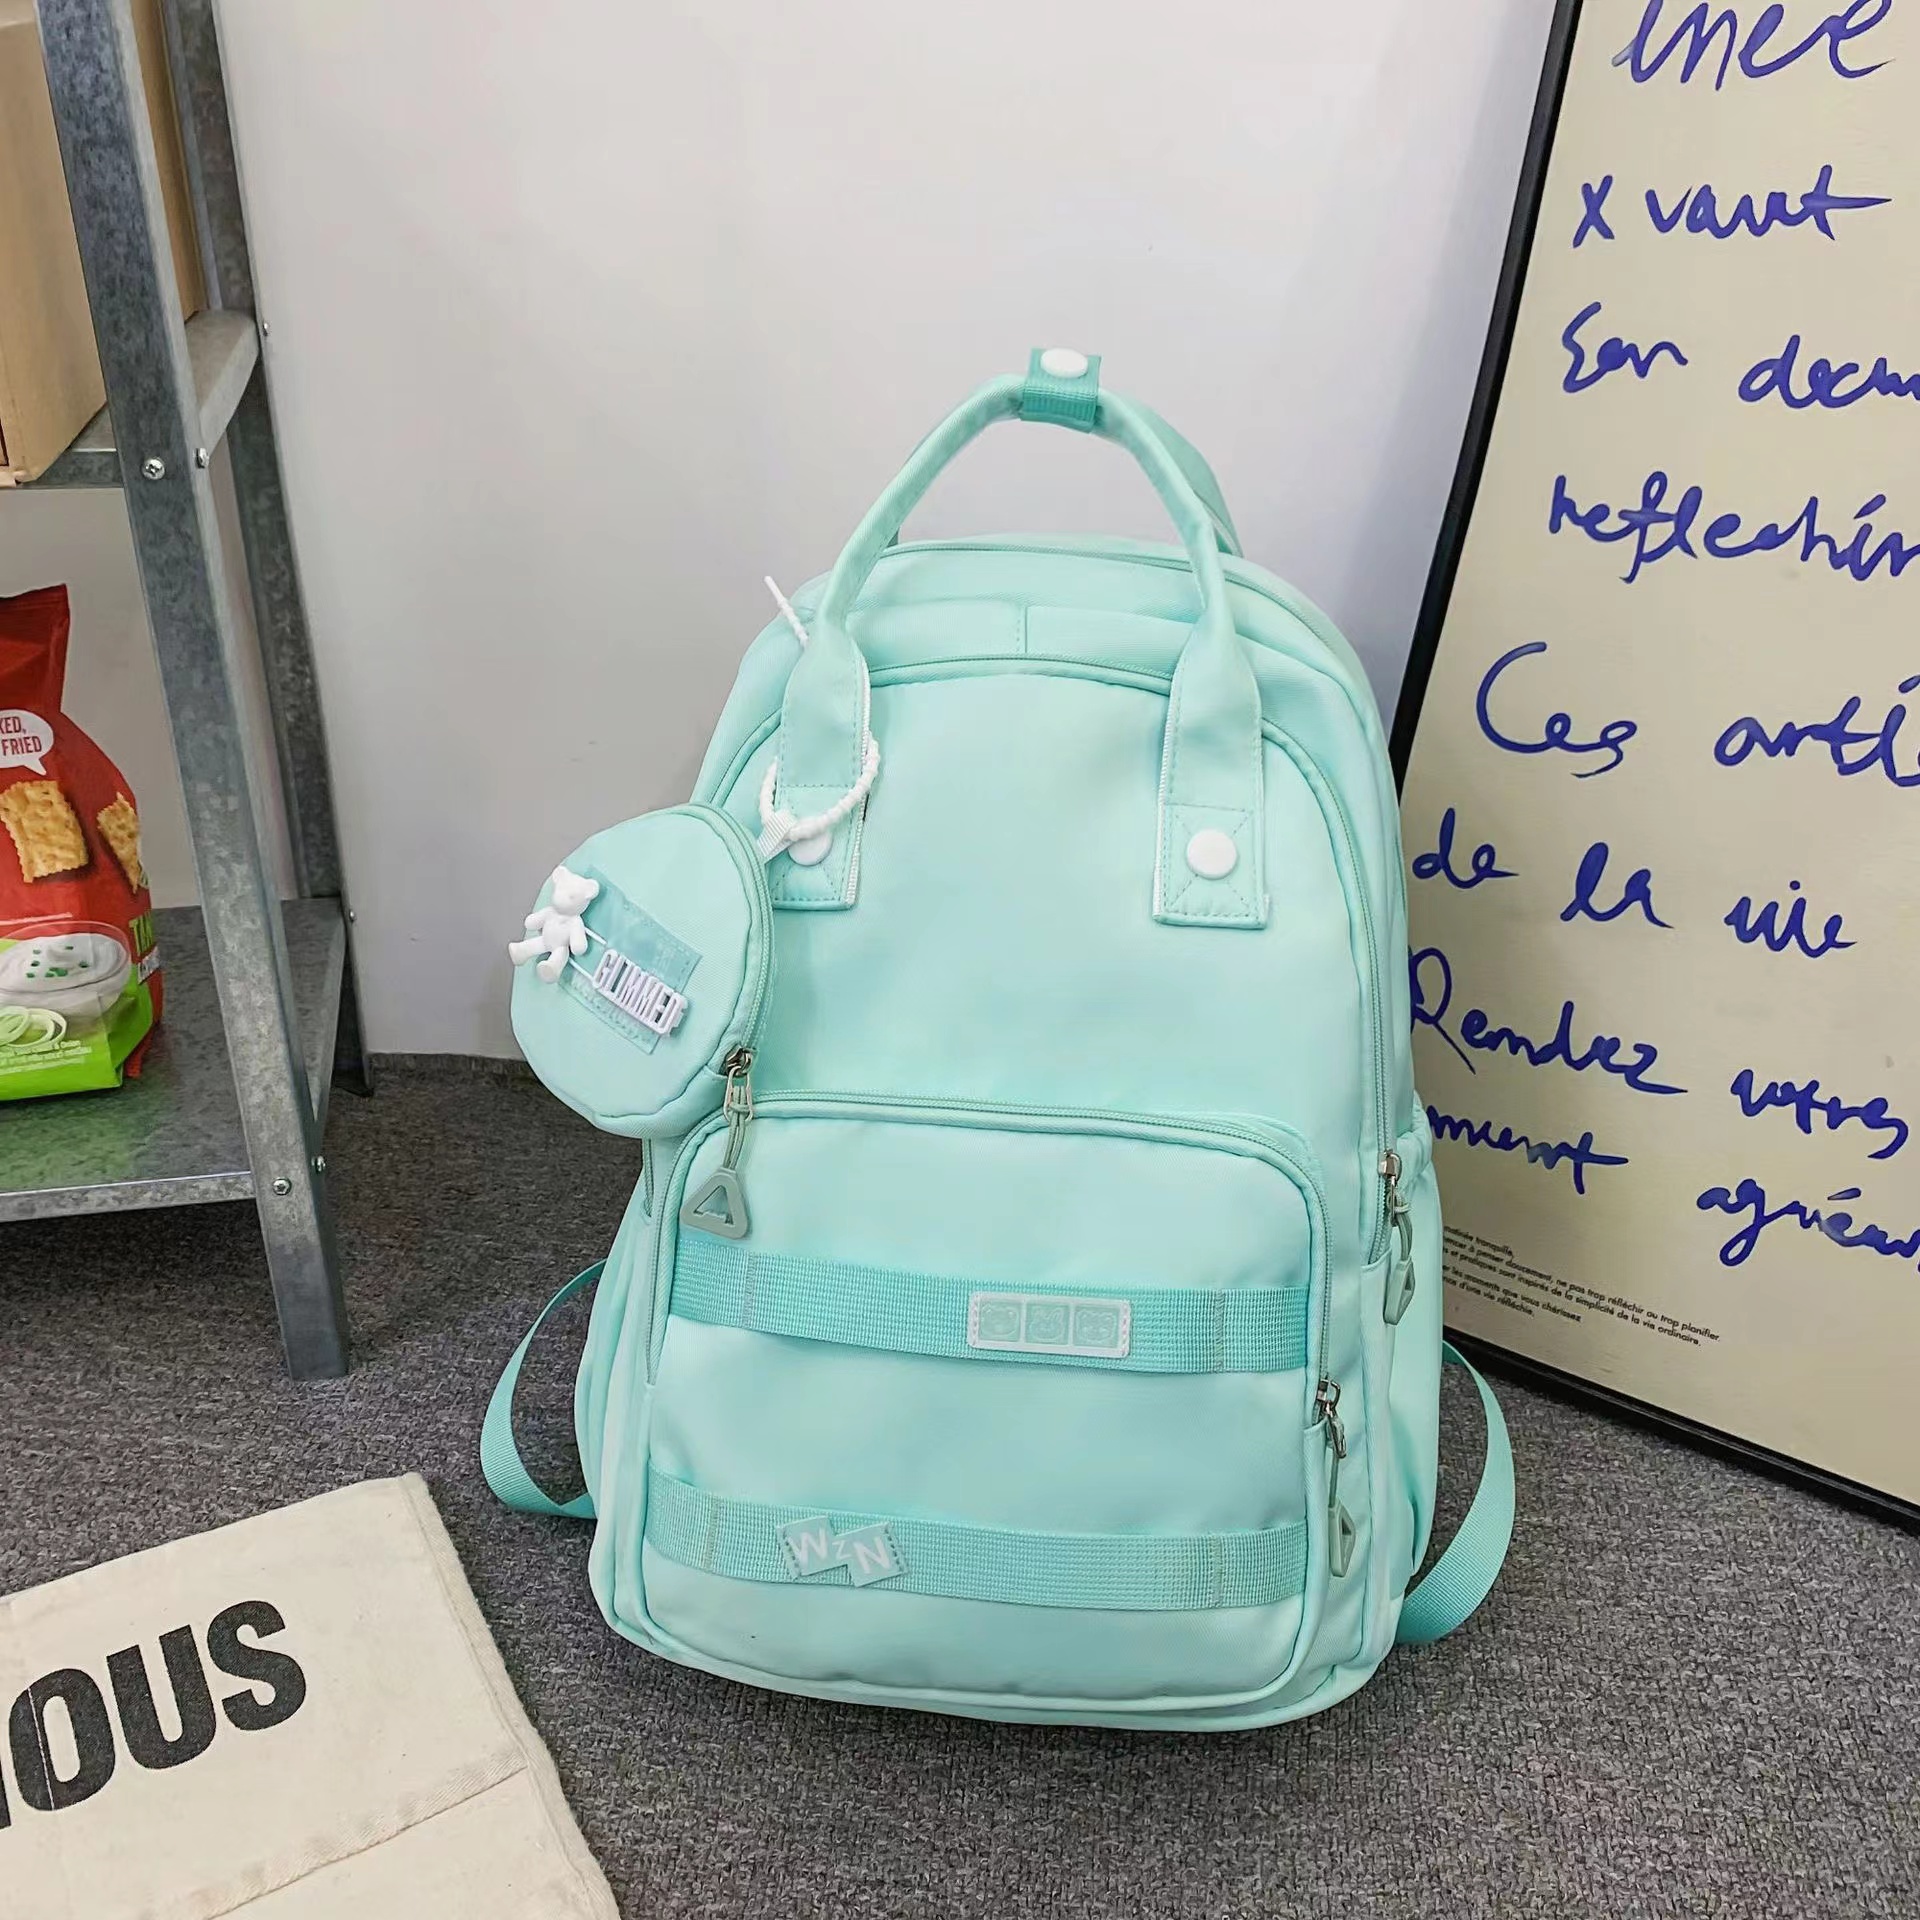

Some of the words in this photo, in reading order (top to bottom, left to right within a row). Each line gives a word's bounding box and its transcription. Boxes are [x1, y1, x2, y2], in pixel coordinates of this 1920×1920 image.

[1, 735, 42, 756] FRIED
[1412, 808, 1519, 889] de
[1560, 842, 1675, 928] la
[1551, 1286, 1563, 1298] de
[1616, 1309, 1629, 1321] de
[1631, 1313, 1640, 1326] la
[1569, 1283, 1586, 1297] pas
[1587, 1288, 1606, 1303] trop
[1607, 1296, 1645, 1315] réfléchir
[1646, 1310, 1659, 1320] ou
[1660, 1314, 1680, 1330] trop
[0, 1600, 307, 1830] OUS
